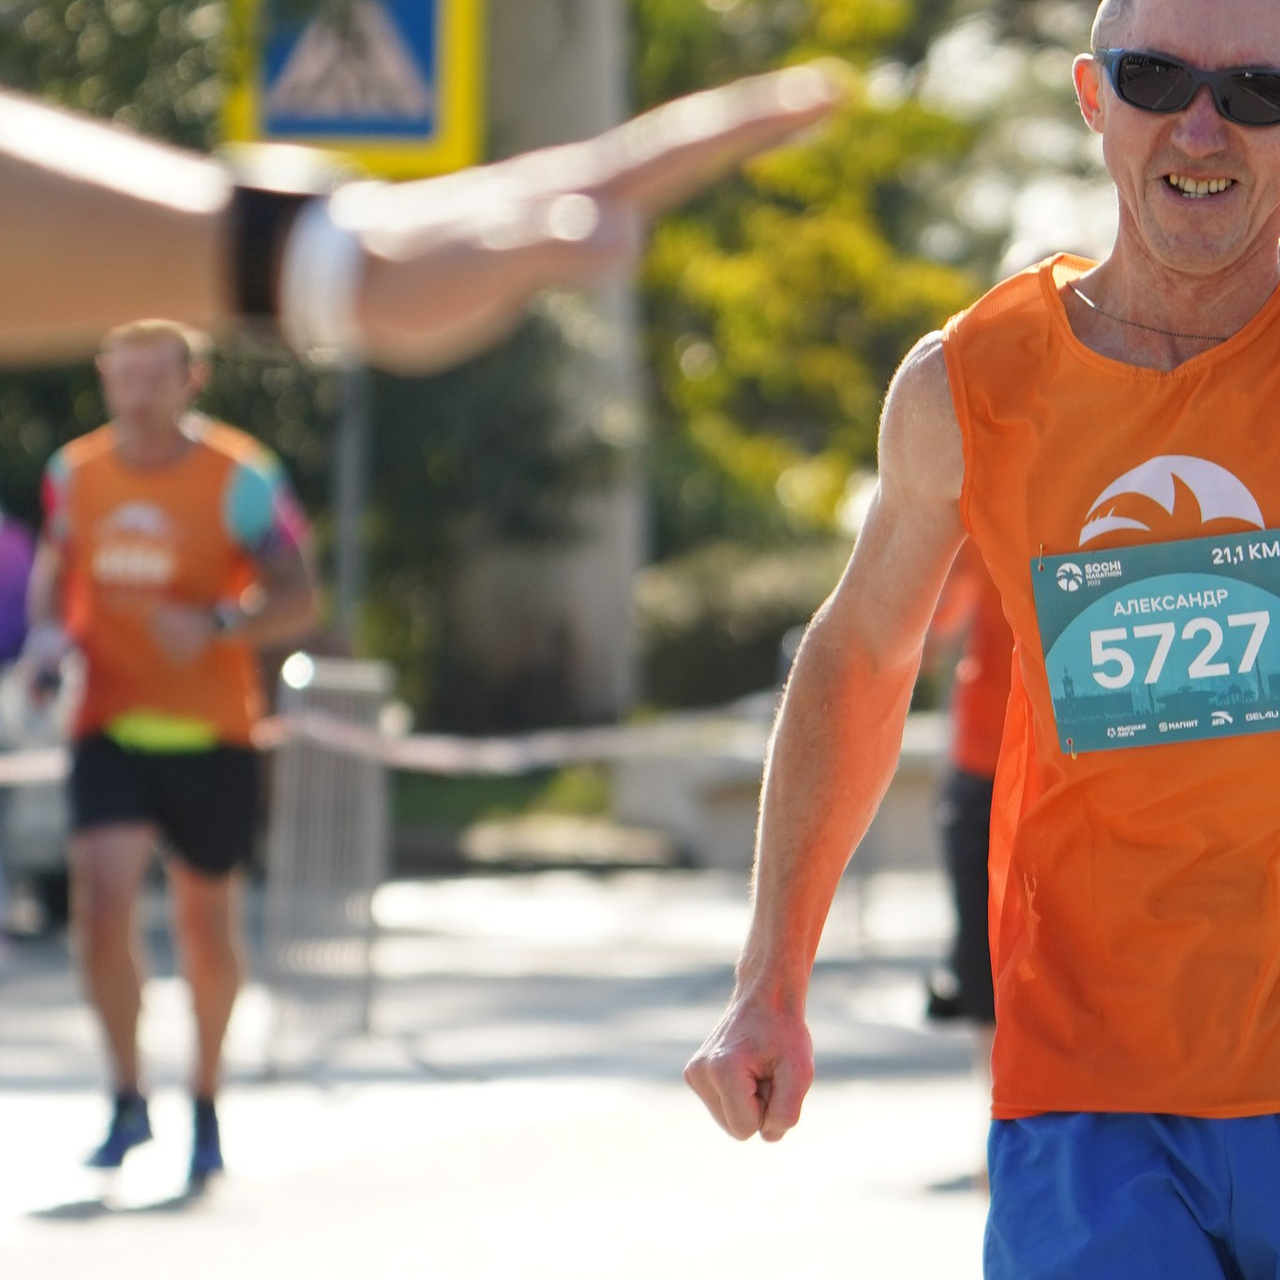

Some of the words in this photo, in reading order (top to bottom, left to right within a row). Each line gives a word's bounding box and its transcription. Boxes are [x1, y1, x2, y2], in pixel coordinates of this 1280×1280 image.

[1212, 546, 1244, 565] 21,1
[1084, 560, 1121, 574] SOCHI
[1085, 569, 1122, 580] MARATHON
[1113, 588, 1228, 616] АЛЕКСАНДР
[1090, 610, 1270, 689] 5727
[1168, 719, 1199, 730] МАГНИТ
